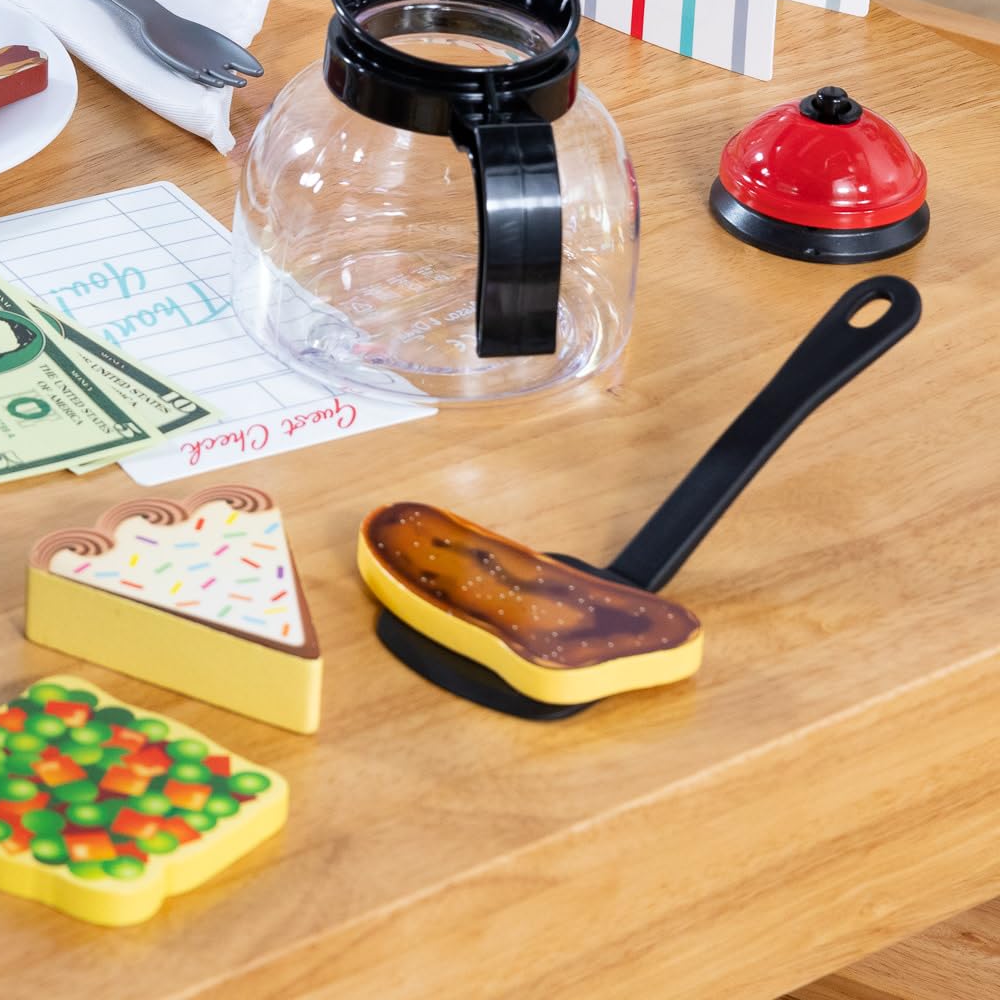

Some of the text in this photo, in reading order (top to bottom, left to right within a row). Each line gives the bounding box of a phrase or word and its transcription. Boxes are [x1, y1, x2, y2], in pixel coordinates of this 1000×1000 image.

[36, 380, 83, 427] OF AMERICA
[39, 363, 113, 436] THE UNITED STATES
[91, 362, 130, 391] UNITED
[129, 387, 171, 415] STATES
[158, 391, 198, 414] 10
[113, 422, 144, 439] 5
[180, 398, 358, 466] Guest Check
